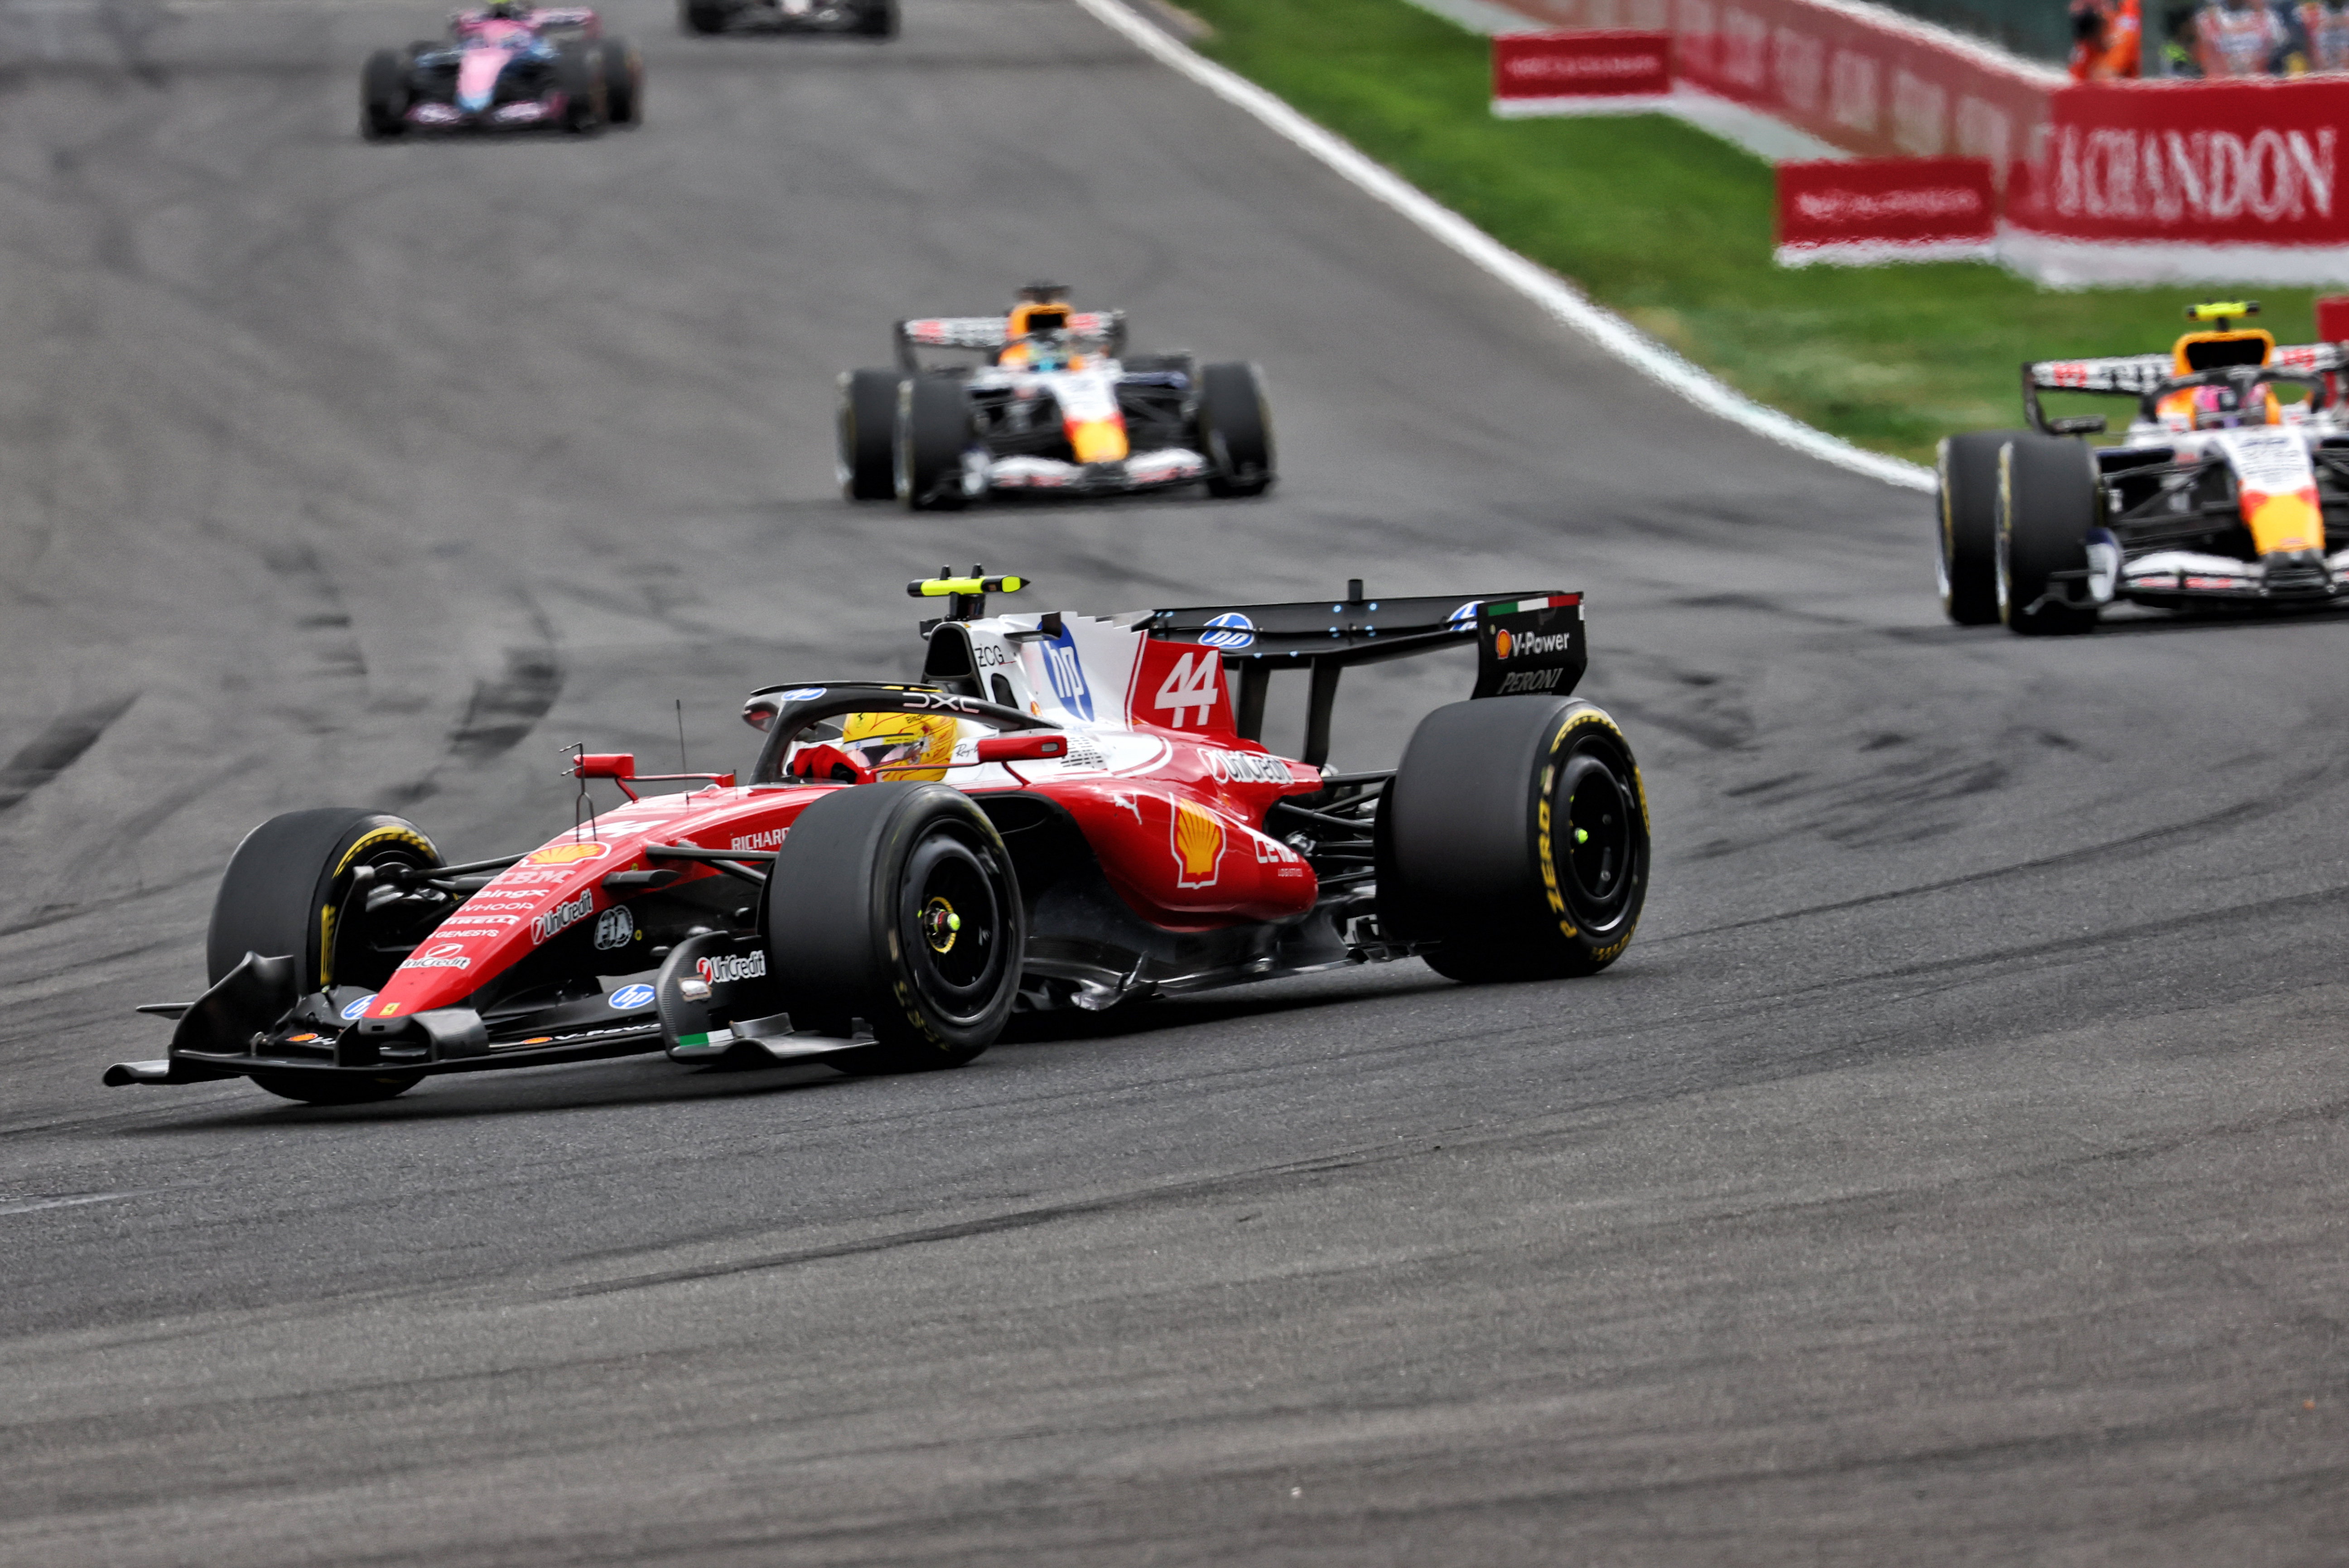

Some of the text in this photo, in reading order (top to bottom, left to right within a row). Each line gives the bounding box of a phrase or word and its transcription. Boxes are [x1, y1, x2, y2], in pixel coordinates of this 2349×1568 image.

[1203, 613, 1249, 647] hp
[1511, 631, 1570, 657] V-Power
[1042, 640, 1088, 721] hp
[1154, 650, 1219, 729] 44
[1496, 667, 1563, 695] PERONI
[902, 692, 980, 714] DXC
[1217, 750, 1294, 784] UniCredit
[563, 820, 670, 839] 44
[492, 870, 576, 885] IBM
[458, 902, 535, 912] WHOOP
[544, 888, 593, 937] UniCredit
[435, 929, 499, 938] GENESYS
[597, 909, 632, 943] FIA
[710, 950, 767, 983] UniCredit
[613, 985, 654, 1009] hp
